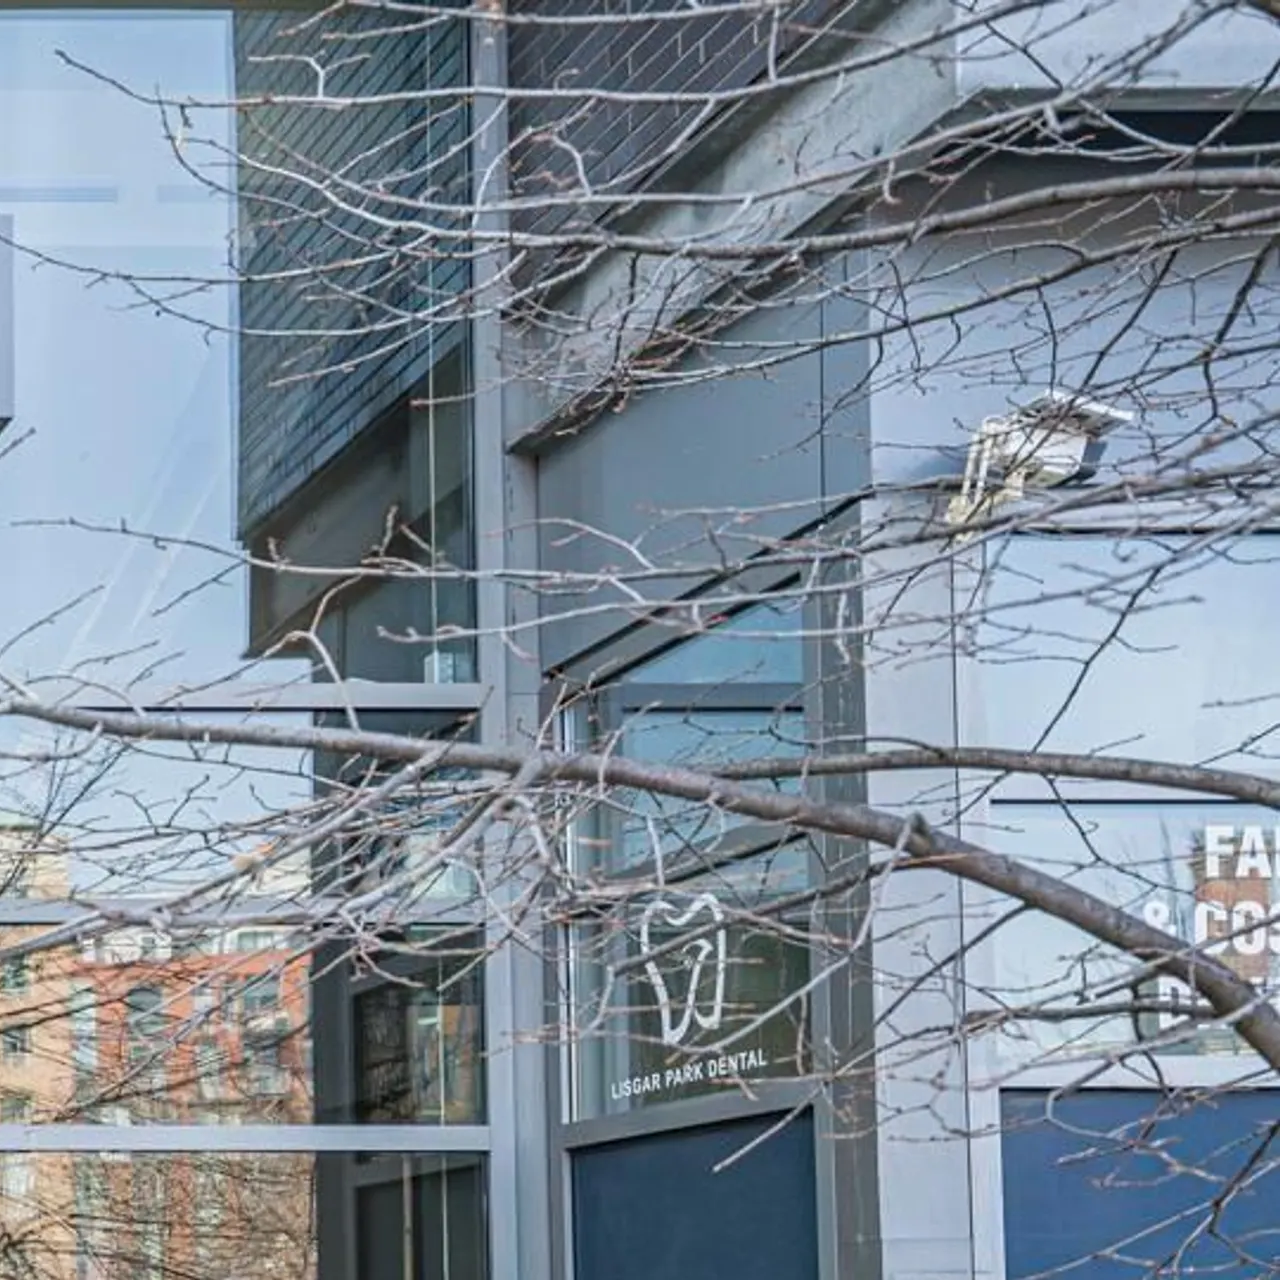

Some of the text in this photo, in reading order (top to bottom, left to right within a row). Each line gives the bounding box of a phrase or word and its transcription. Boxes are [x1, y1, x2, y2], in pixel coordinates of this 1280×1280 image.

[1205, 825, 1280, 878] FA
[611, 1048, 767, 1100] LISGAR PARK DENTAL
